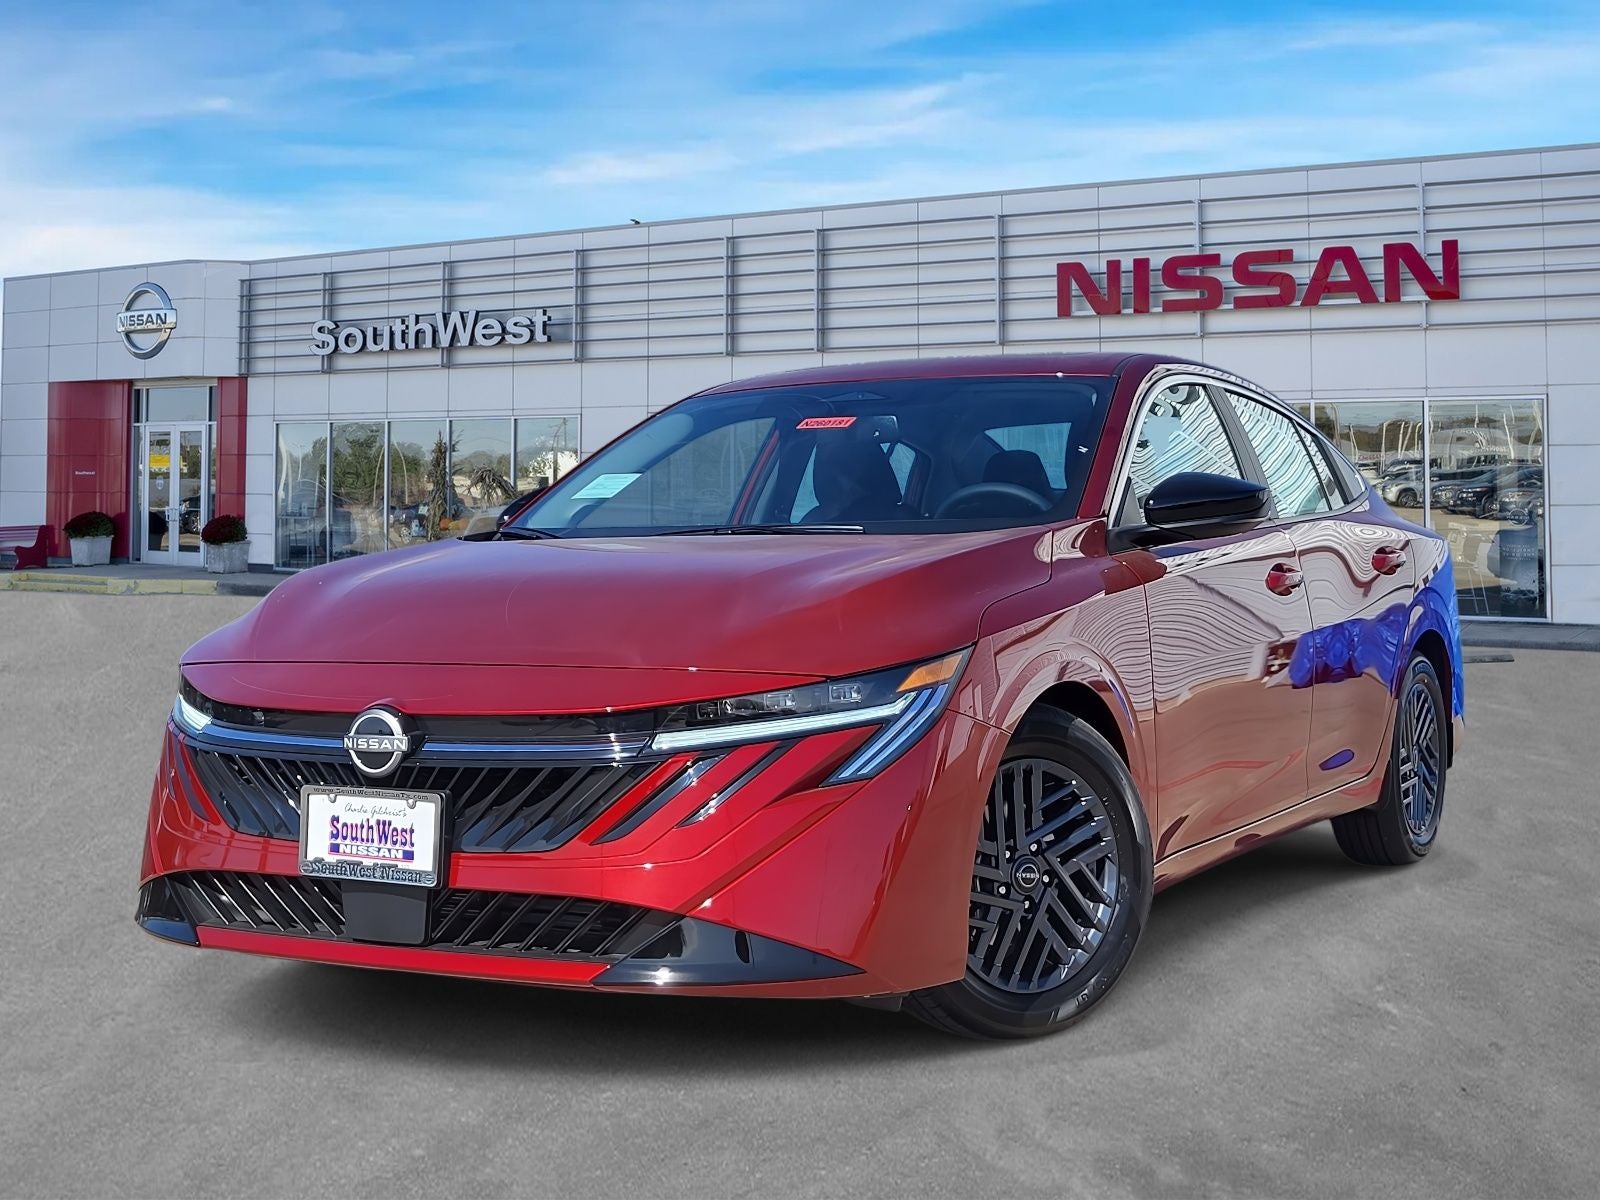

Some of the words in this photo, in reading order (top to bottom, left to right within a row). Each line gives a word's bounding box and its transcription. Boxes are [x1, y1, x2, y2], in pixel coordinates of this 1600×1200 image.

[1056, 239, 1461, 318] NISSAN
[119, 312, 168, 328] NISSAN
[308, 308, 552, 356] SouthWest
[343, 737, 407, 751] NISSAN
[330, 814, 415, 848] SouthWest
[339, 844, 404, 859] NISSAN
[313, 860, 380, 878] SouthWest
[380, 866, 422, 883] Nissan
